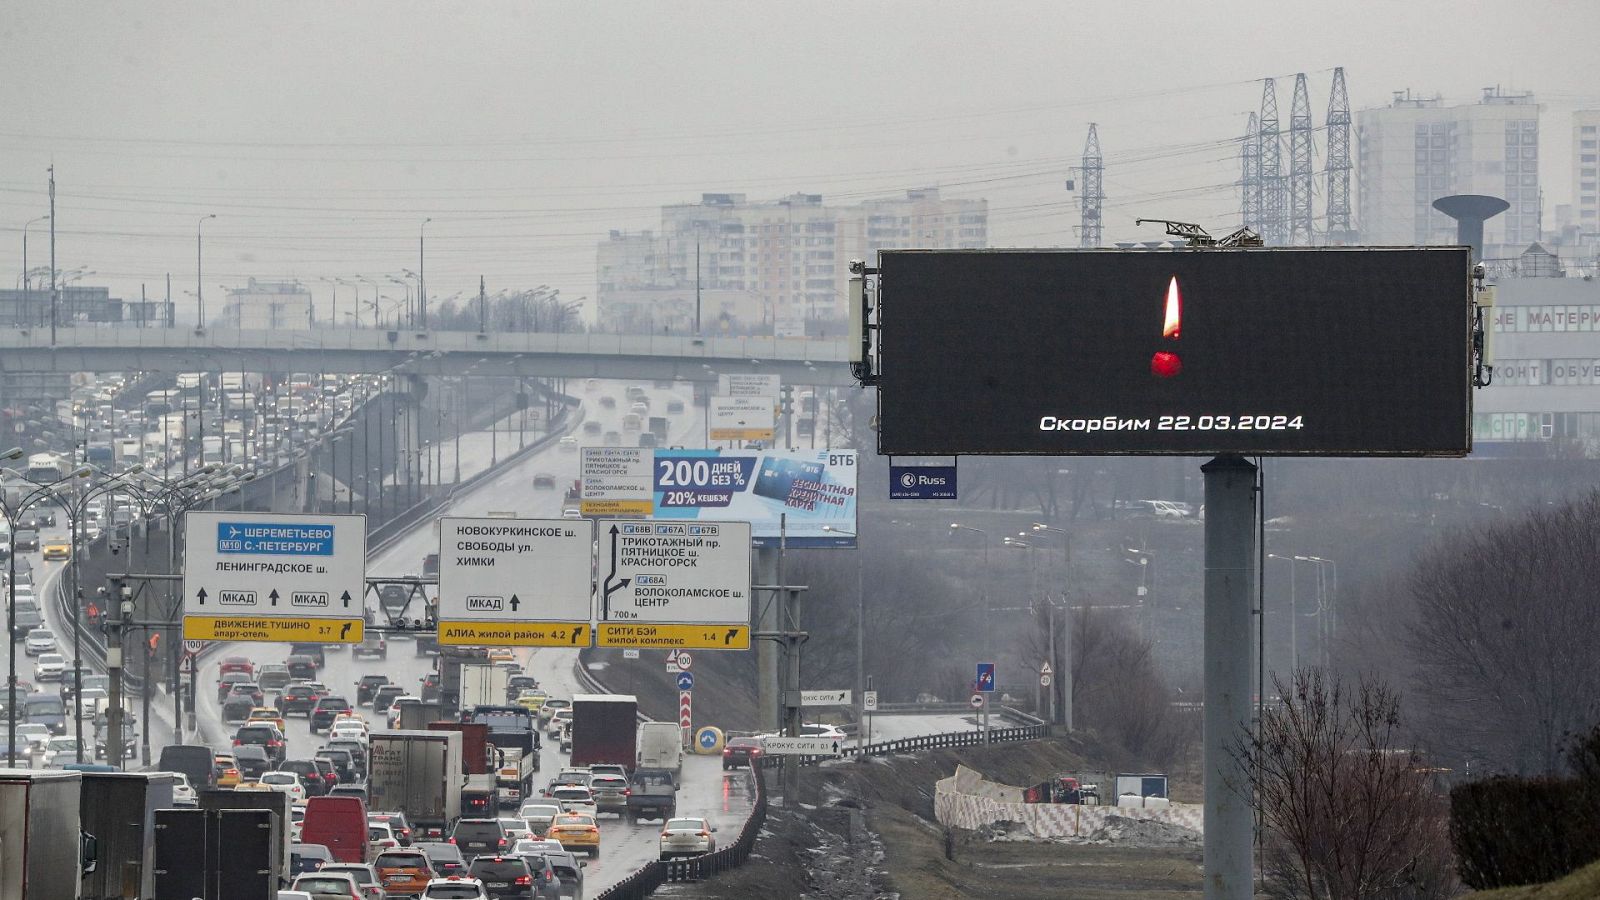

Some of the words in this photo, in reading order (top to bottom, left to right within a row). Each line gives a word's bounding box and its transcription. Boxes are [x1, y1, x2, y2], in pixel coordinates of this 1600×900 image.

[1039, 416, 1150, 433] Скорбим
[1157, 415, 1304, 431] 22.03.2024
[829, 454, 854, 466] ВТБ
[659, 460, 710, 486] 200
[711, 460, 741, 475] ДНЕЙ
[711, 474, 731, 486] БЕЗ
[733, 473, 745, 486] %
[918, 475, 946, 485] Russ
[792, 479, 854, 496] БЕСПЛАТНАЯ
[667, 491, 696, 505] 20%
[697, 494, 729, 503] КЕШБЭК
[789, 488, 845, 506] КРЕДИТНАЯ
[785, 496, 814, 511] КАРТА
[244, 528, 331, 539] ШЕРЕМЕТЬЕВО
[456, 526, 561, 537] НОВОКУРКИНСКОЕ
[221, 540, 240, 550] М10
[244, 541, 323, 551] С.-ПЕТЕРБУРГ
[457, 541, 514, 551] СВОБОДЫ
[518, 544, 533, 553] ул.
[621, 536, 702, 546] ТРИКОТАЖНЫЙ
[705, 540, 720, 548] пр.
[621, 547, 685, 557] ПЯТНИЦКОЕ
[456, 557, 494, 566] ХИМКИ
[621, 557, 697, 566] КРАСНОГОРСК
[216, 561, 312, 574] ЛЕНИНГРАДСКОЕ
[634, 587, 729, 598] ВОЛОКОЛАМСКОЕ
[732, 590, 744, 598] ш.
[221, 593, 255, 604] МКАД
[294, 594, 326, 605] МКАД
[469, 599, 501, 609] МКАД
[634, 598, 669, 607] ЦЕНТР
[213, 620, 267, 629] ДВИЖЕНИЕ
[270, 621, 310, 629] ТУШИНО
[318, 626, 331, 634] 3.7
[607, 626, 634, 635] СИТИ
[637, 626, 656, 635] БЭЙ
[213, 630, 269, 638] апарт-отель
[445, 628, 475, 638] АЛИА
[478, 629, 511, 639] жилой
[513, 630, 544, 640] район
[550, 630, 565, 639] 4.2
[186, 640, 200, 648] 100
[679, 656, 691, 665] 100
